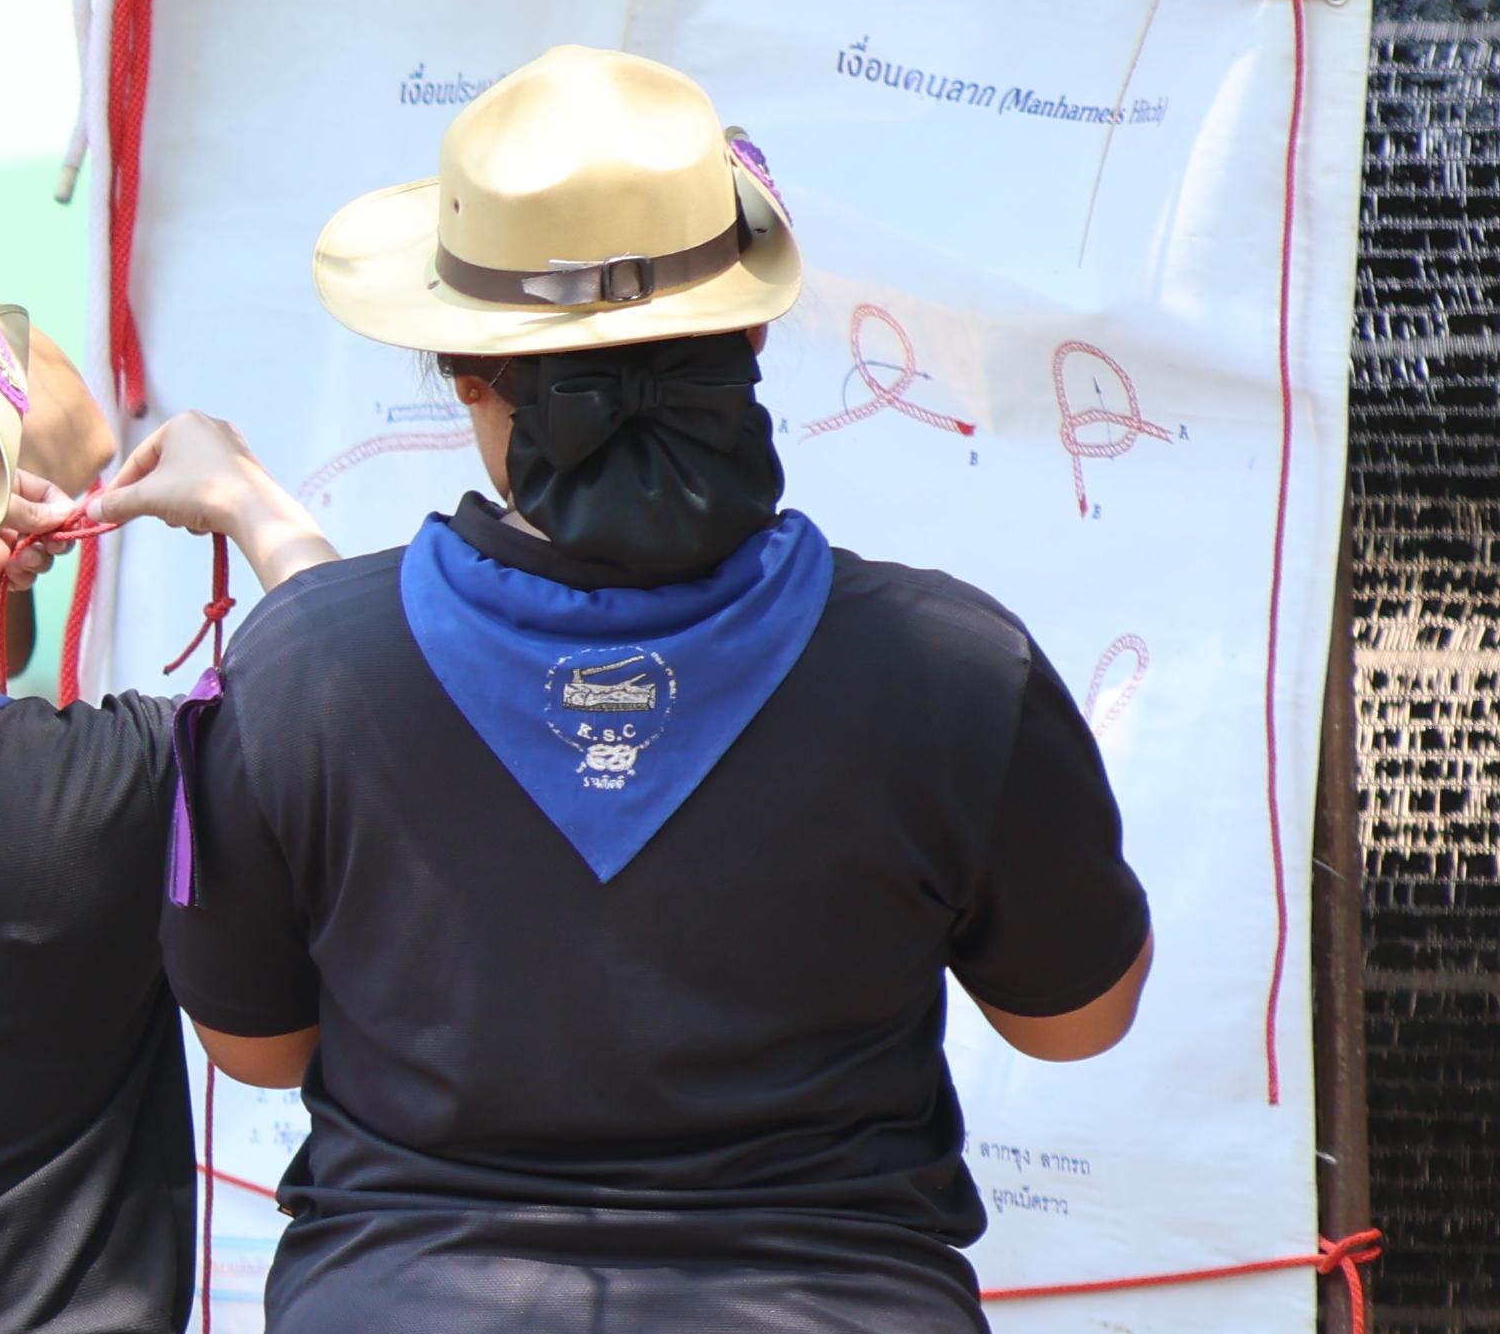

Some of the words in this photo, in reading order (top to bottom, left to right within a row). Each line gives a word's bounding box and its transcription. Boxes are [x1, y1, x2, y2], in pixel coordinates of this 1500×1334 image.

[836, 36, 996, 108] เงื่อนคนลาก
[998, 85, 1126, 126] (Manharness
